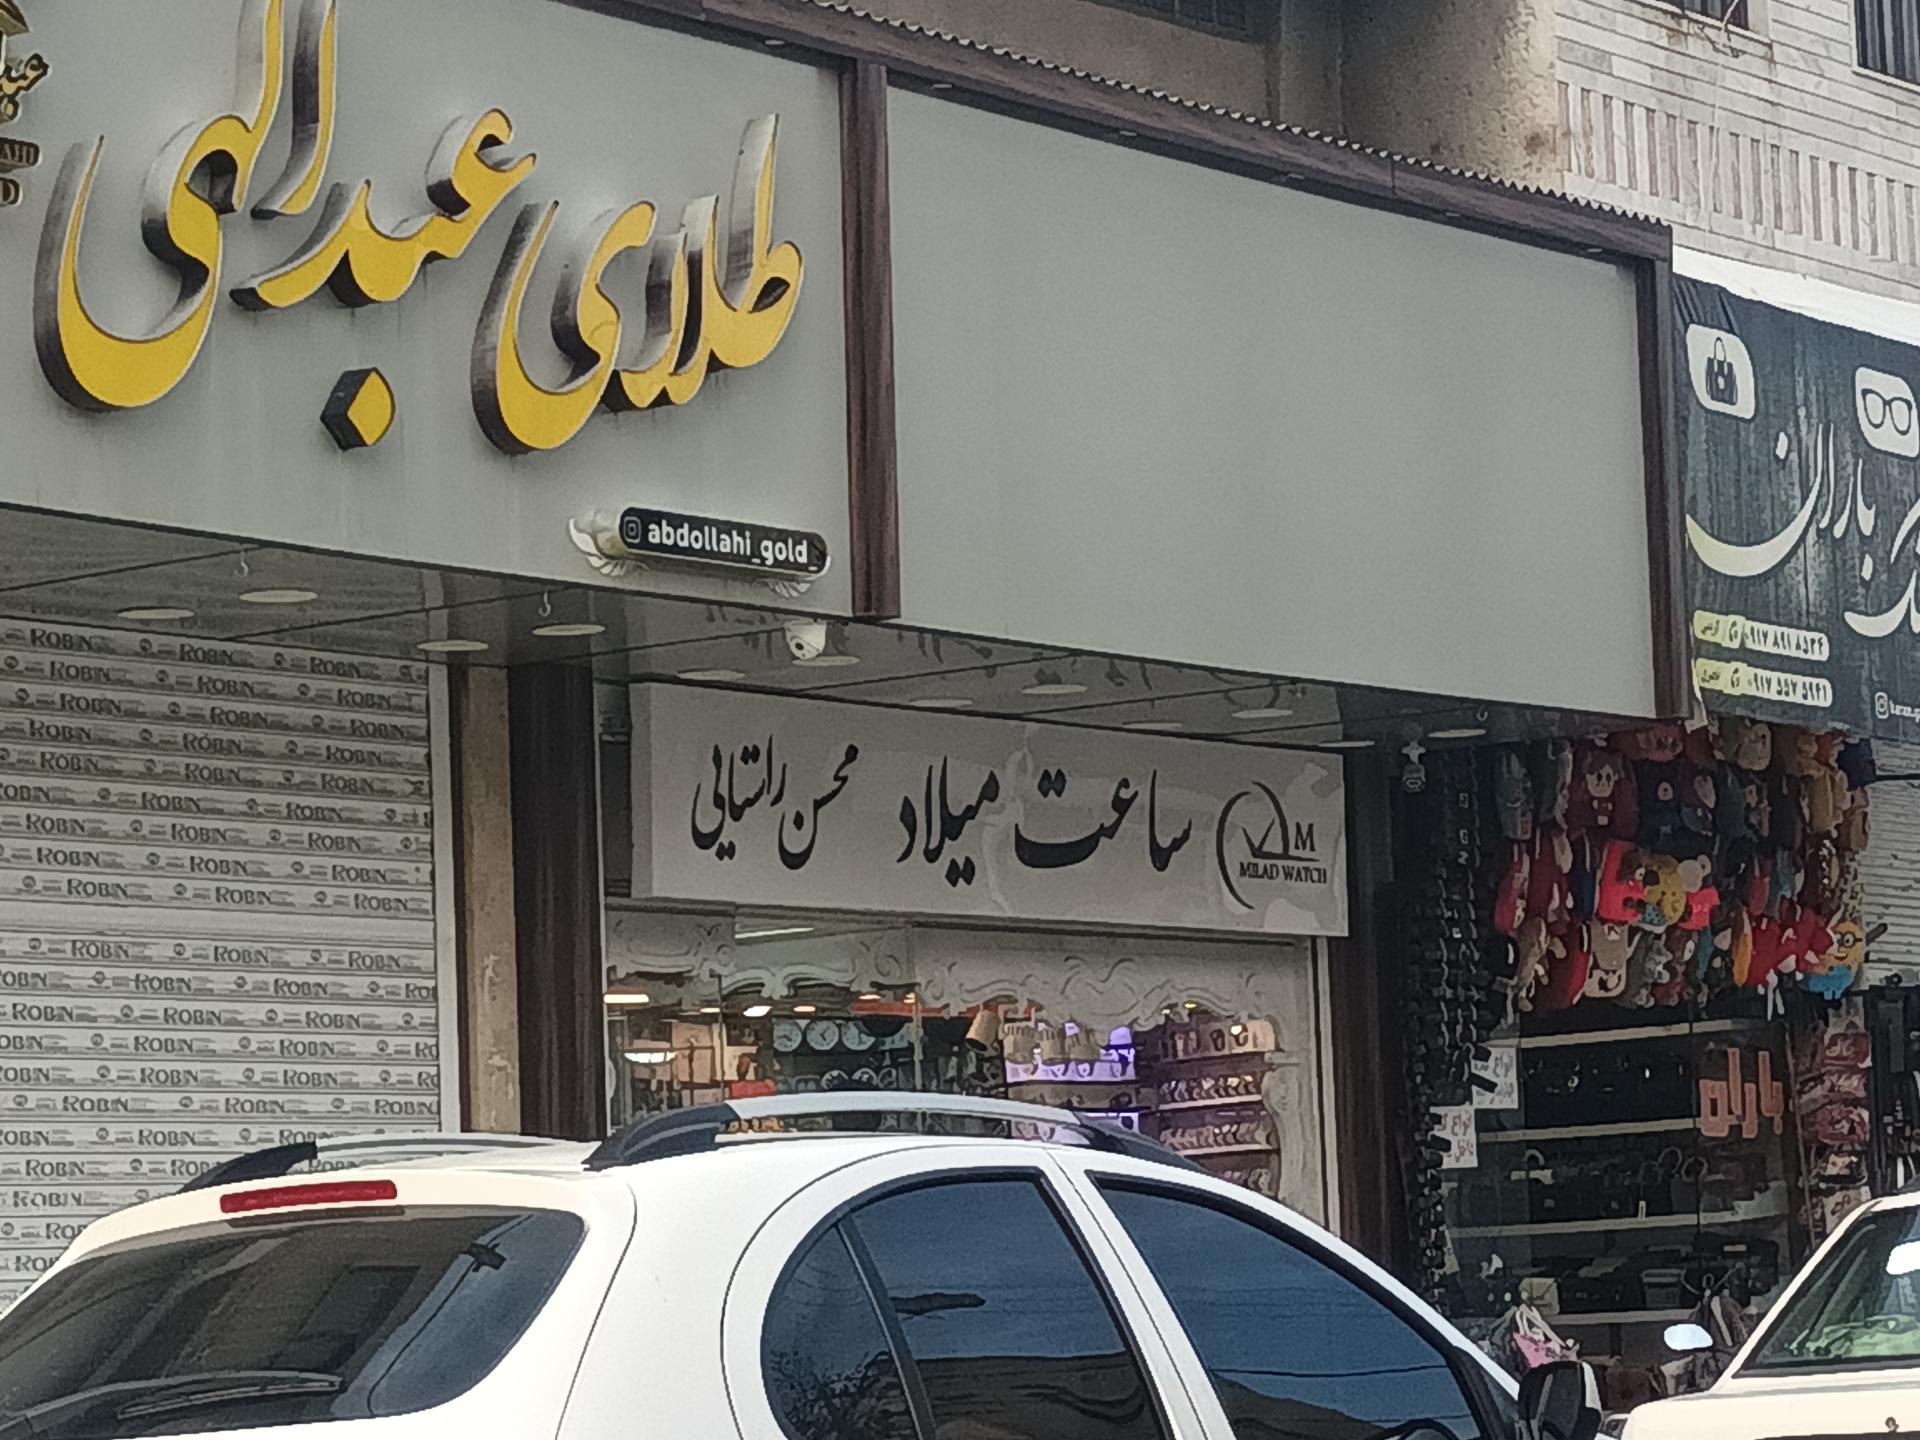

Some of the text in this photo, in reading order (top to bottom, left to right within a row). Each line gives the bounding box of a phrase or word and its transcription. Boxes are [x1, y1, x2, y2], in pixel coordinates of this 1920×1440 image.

[471, 112, 804, 452] طلای
[1686, 421, 1876, 578] باران
[0, 783, 50, 800] OBIN
[778, 743, 859, 870] محسن
[896, 755, 1000, 888] میلاد
[1014, 768, 1192, 872] ساعت
[1294, 821, 1316, 852] M
[1281, 864, 1328, 884] WATCH
[0, 971, 47, 988] OBIN
[0, 1034, 44, 1050] OBIN
[0, 1066, 50, 1082] OBIN
[0, 1129, 50, 1146] OBIN
